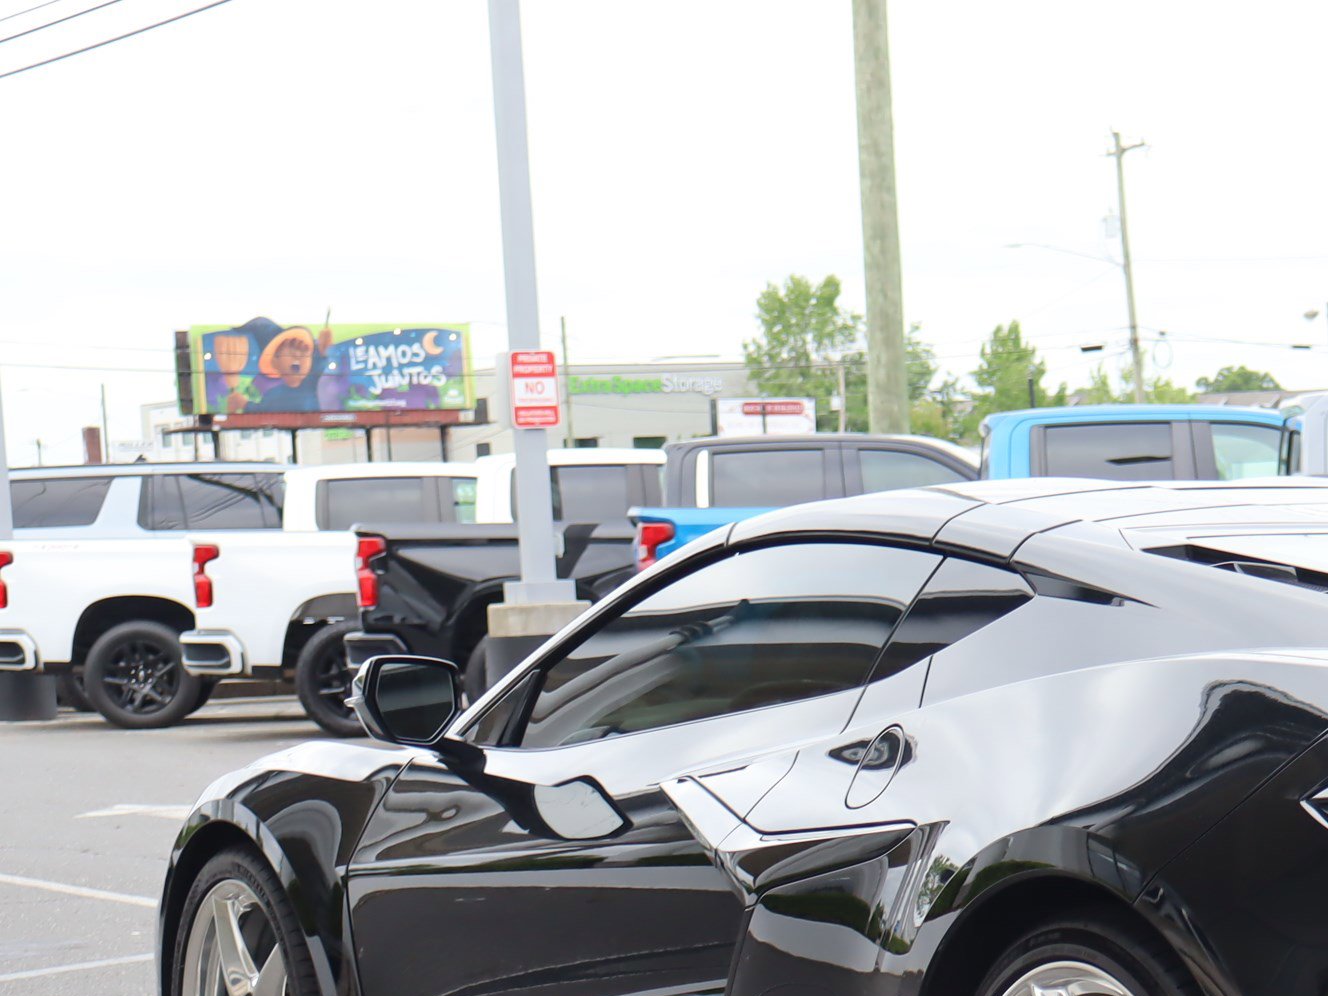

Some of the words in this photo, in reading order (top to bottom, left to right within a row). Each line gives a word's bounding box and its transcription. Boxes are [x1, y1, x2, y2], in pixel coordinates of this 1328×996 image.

[348, 342, 426, 370] LEAMOS
[524, 381, 546, 395] NO
[660, 373, 723, 395] Storage
